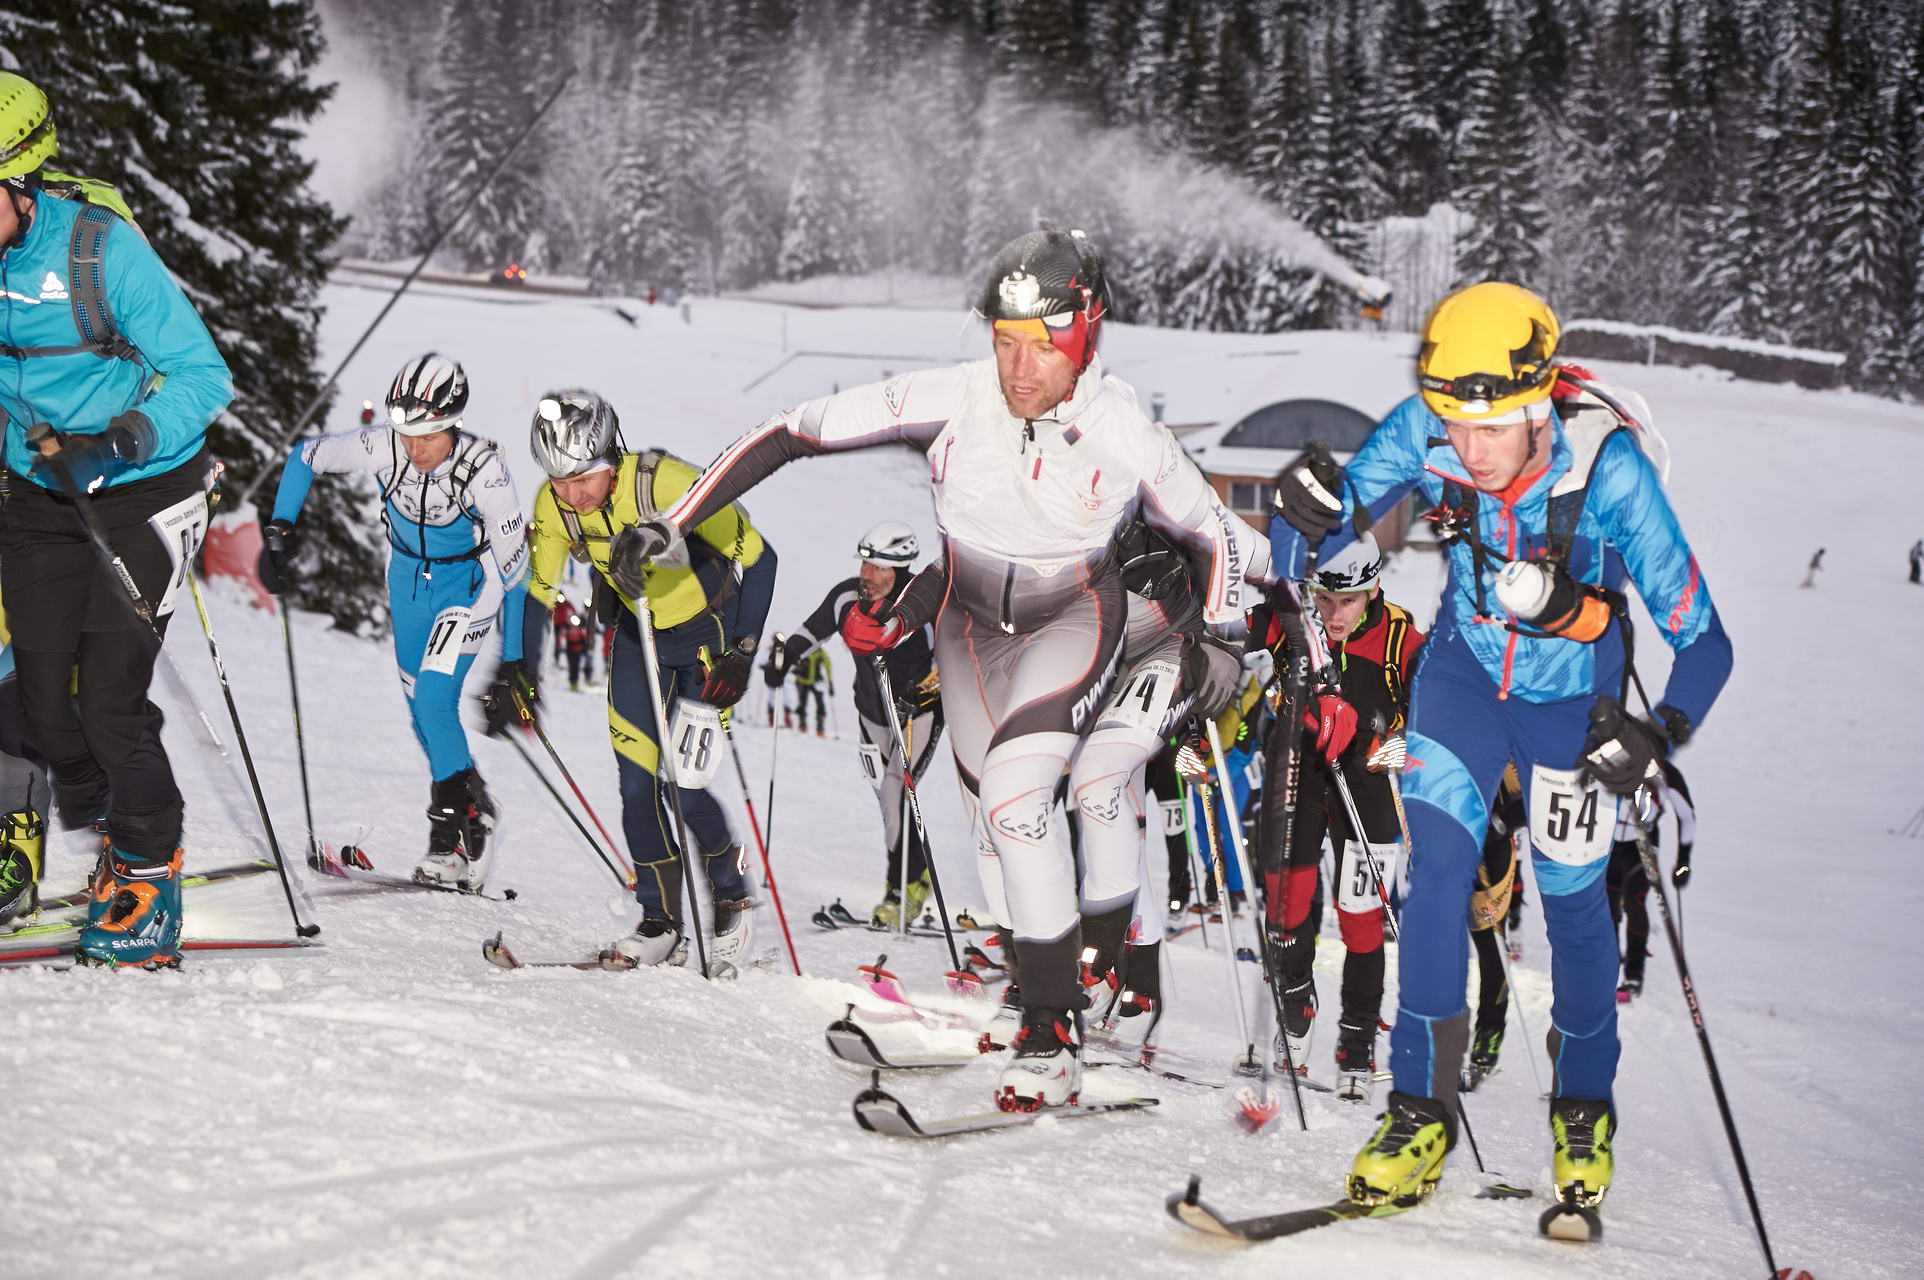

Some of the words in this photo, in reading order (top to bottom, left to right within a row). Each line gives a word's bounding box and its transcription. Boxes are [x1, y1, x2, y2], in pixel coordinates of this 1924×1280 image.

[427, 620, 458, 656] 47
[678, 723, 715, 772] 48
[1547, 789, 1599, 843] 54
[111, 938, 158, 950] SCARPA
